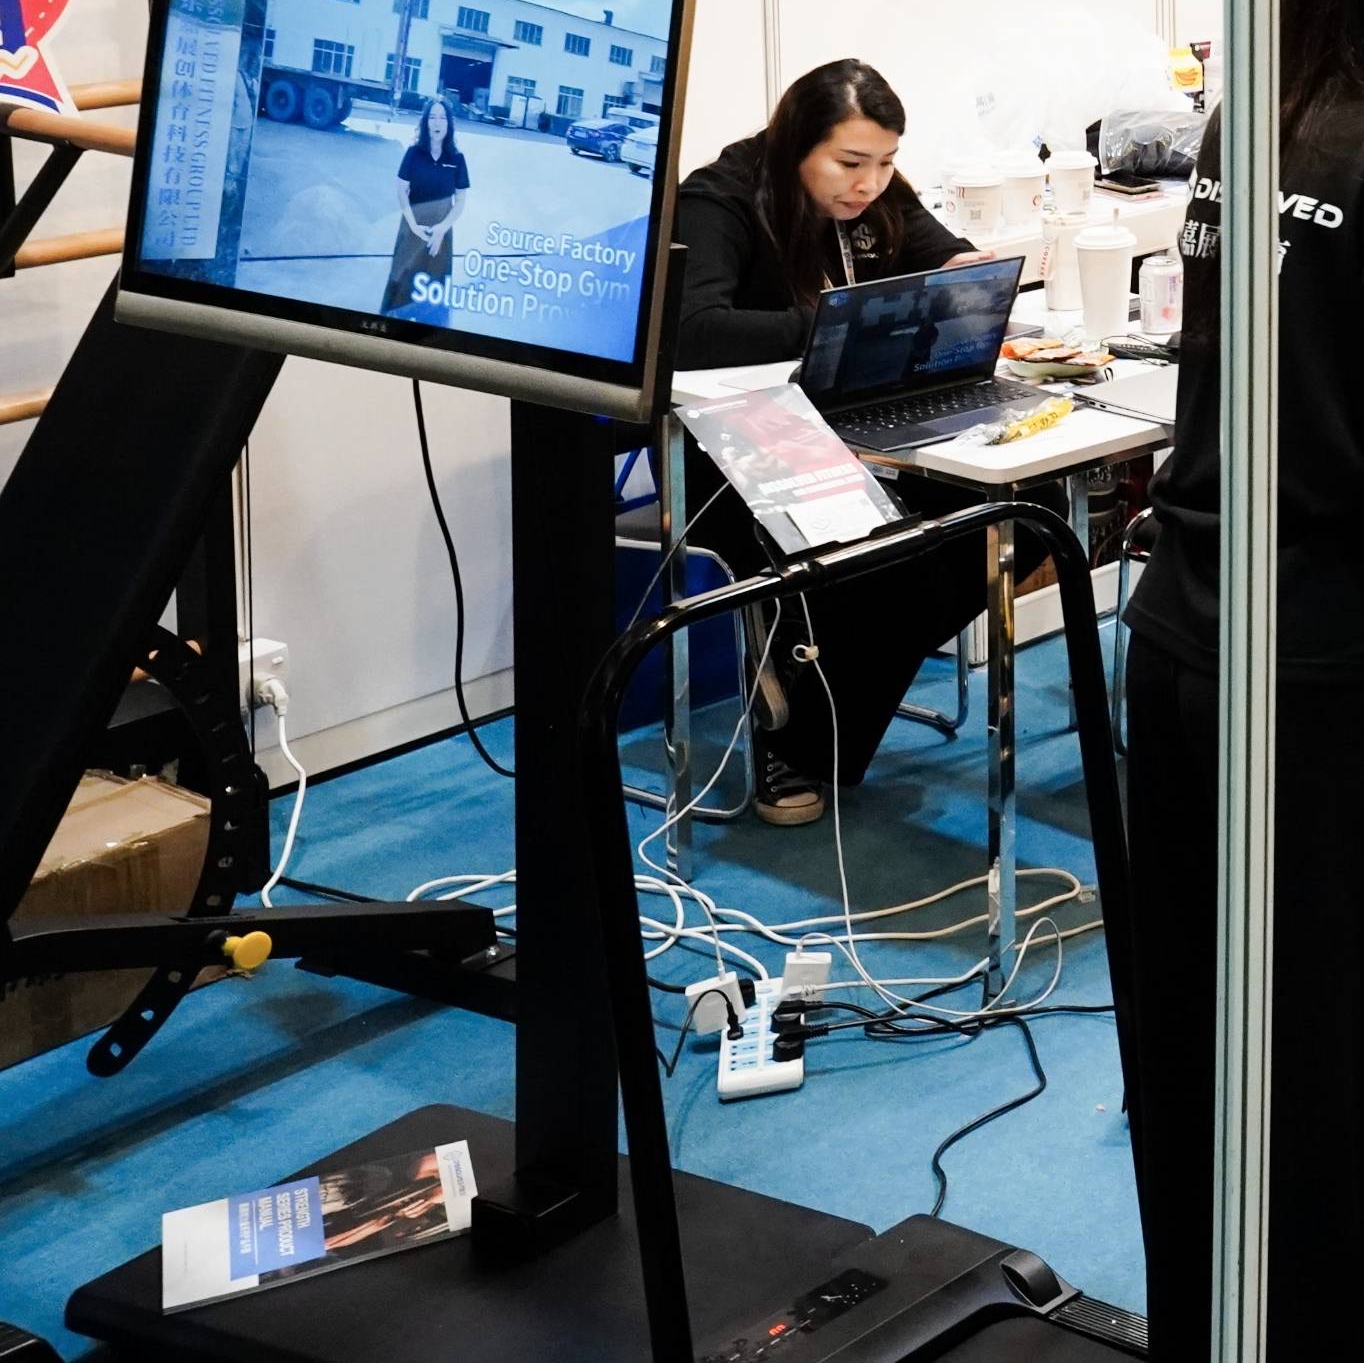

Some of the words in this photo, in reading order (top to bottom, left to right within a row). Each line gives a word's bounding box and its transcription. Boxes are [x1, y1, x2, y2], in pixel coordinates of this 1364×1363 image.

[486, 221, 560, 254] Source
[559, 234, 636, 274] Factory
[410, 271, 515, 319] Solution
[464, 249, 573, 298] One-Stop
[578, 270, 631, 305] Gym
